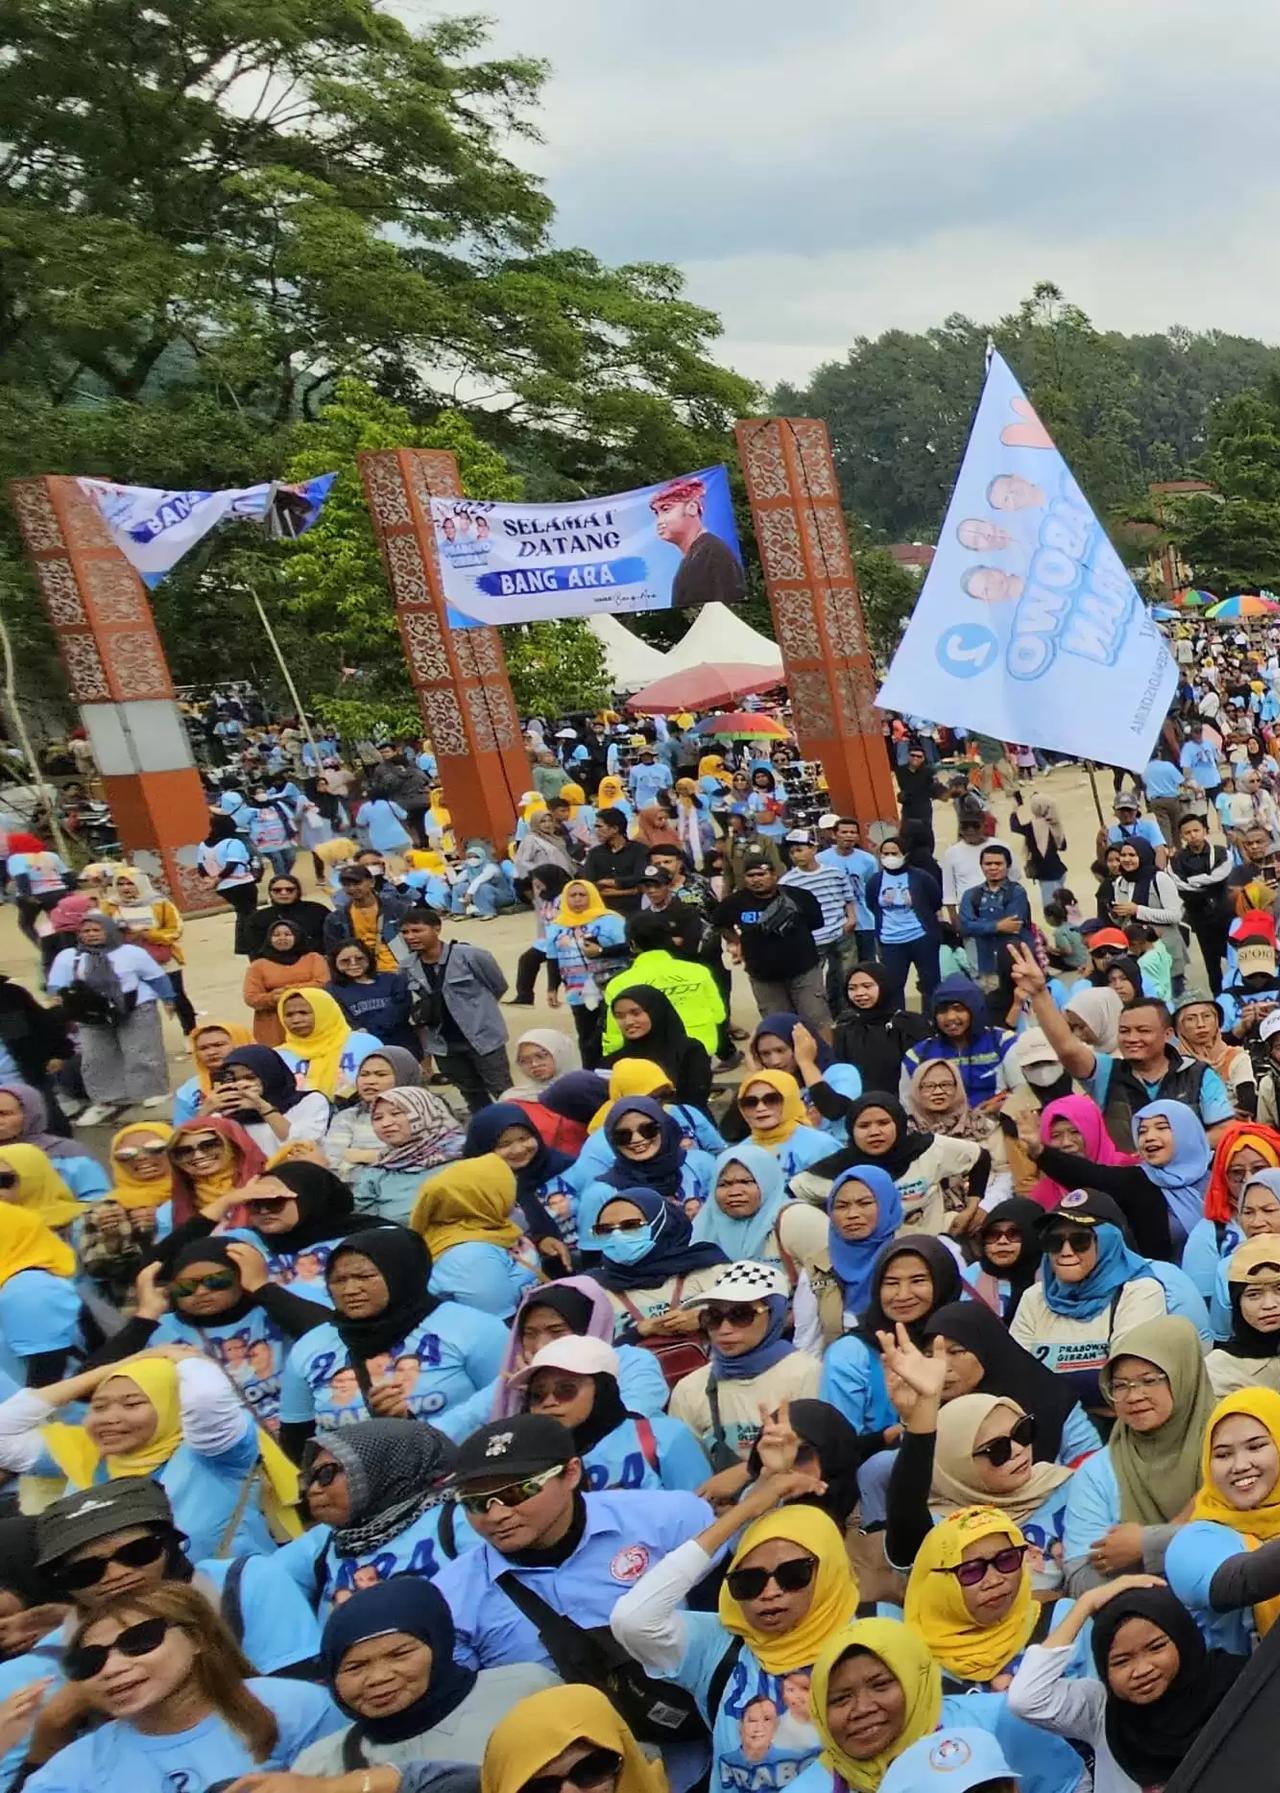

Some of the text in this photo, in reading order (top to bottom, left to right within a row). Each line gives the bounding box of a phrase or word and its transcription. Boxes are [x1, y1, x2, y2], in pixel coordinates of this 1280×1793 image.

[503, 509, 617, 538] SELAMAT
[517, 532, 620, 558] DATANG
[500, 563, 616, 597] BANG ARA
